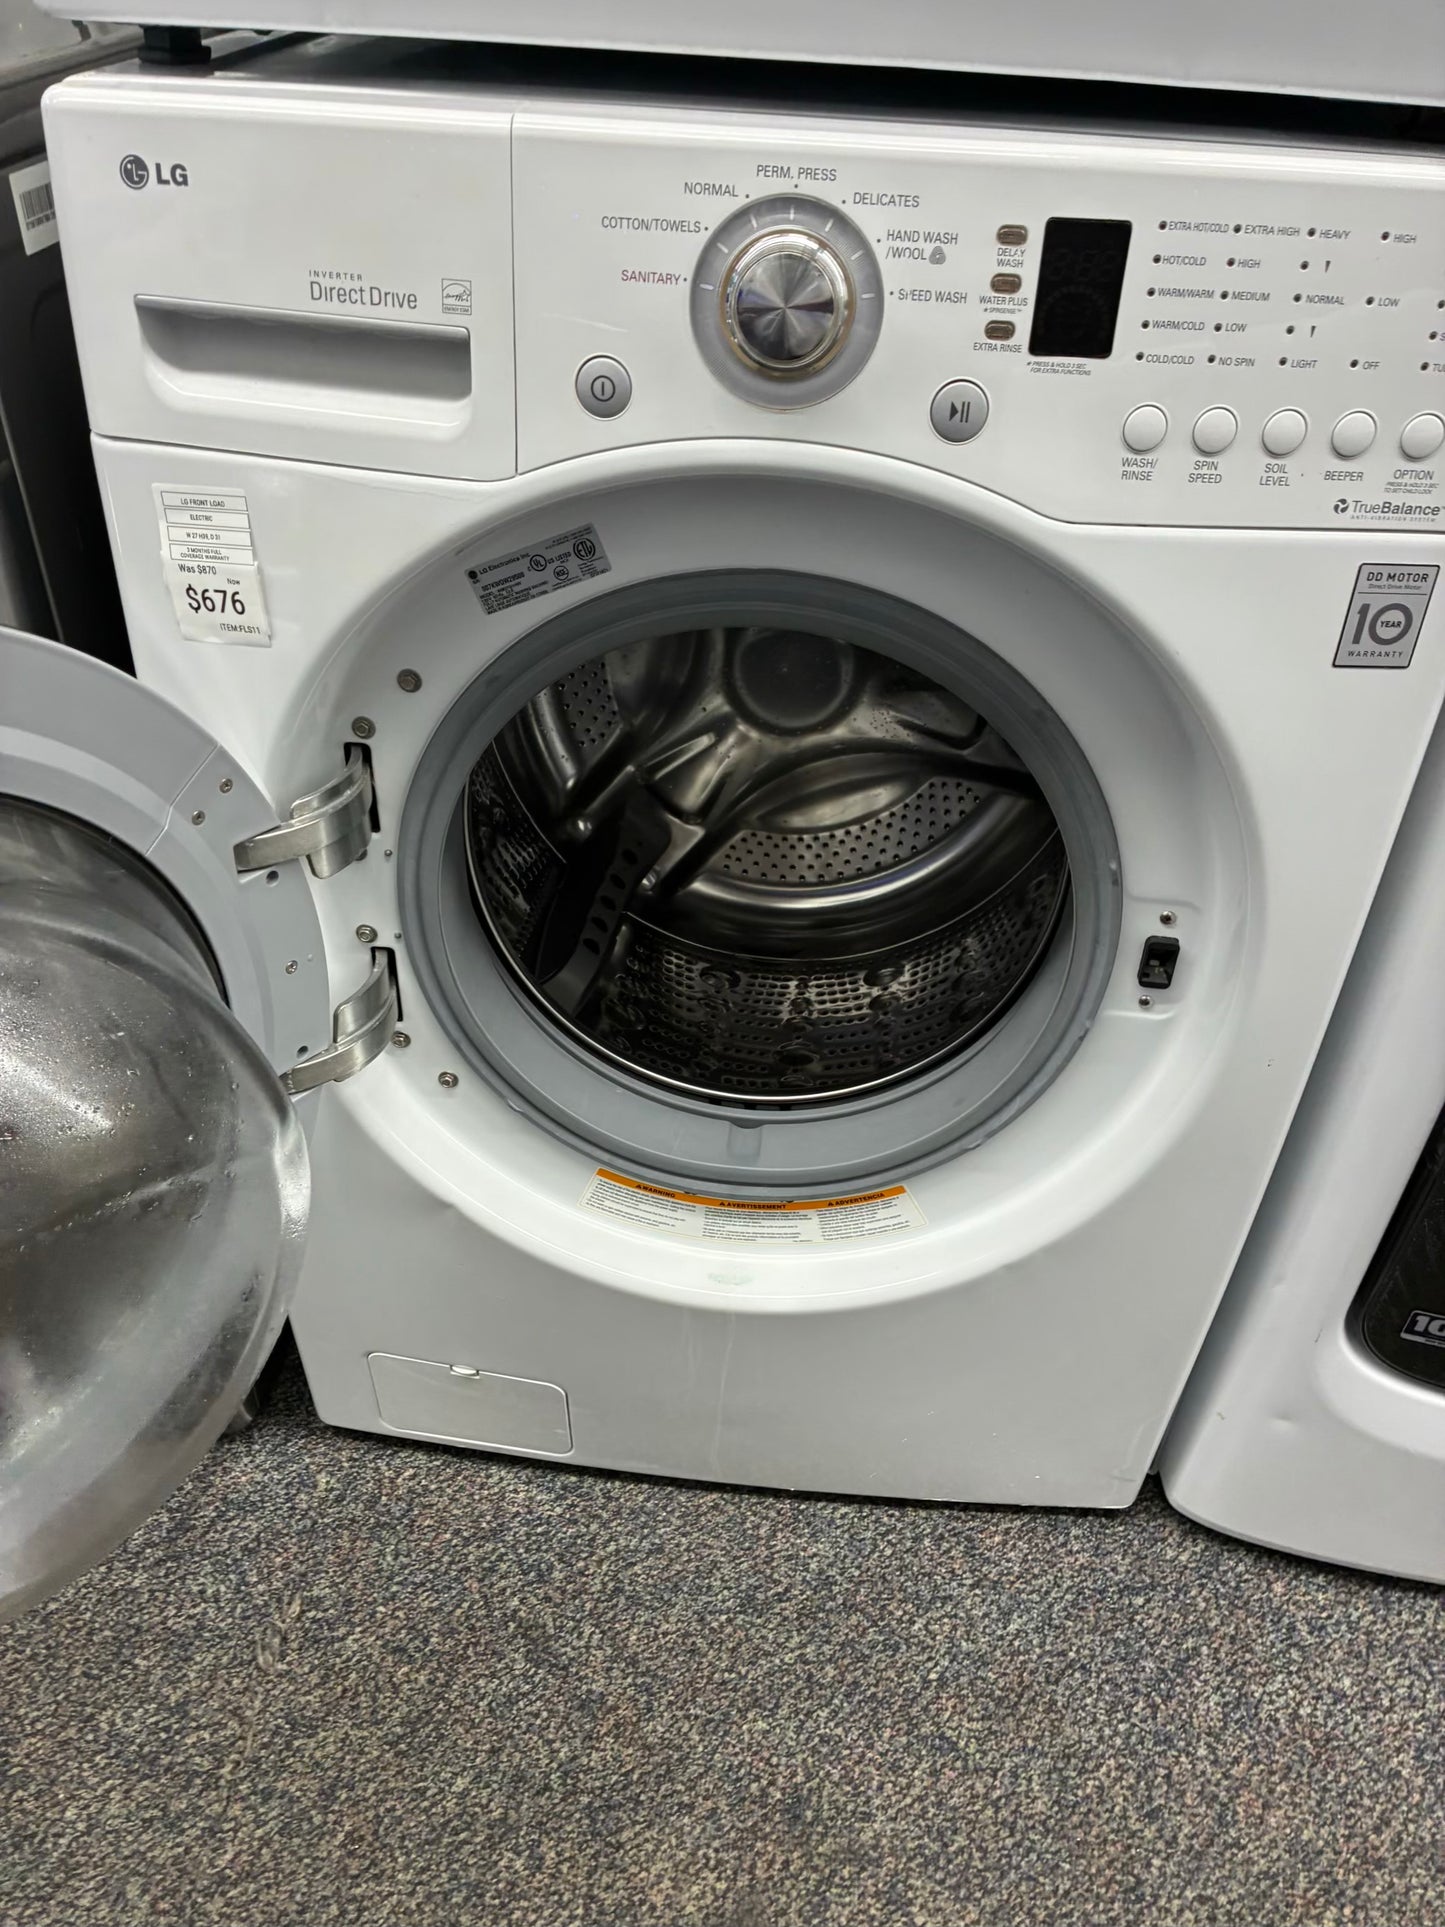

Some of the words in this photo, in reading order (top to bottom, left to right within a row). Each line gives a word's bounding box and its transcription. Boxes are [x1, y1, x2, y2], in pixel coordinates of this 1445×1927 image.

[155, 163, 189, 187] LG
[756, 164, 794, 179] PERM.
[798, 167, 837, 181] PRESS
[684, 182, 738, 197] NORMAL
[853, 192, 920, 208] DELICATES
[601, 216, 701, 233] COTTON/TOWELS
[1169, 221, 1192, 231] EXTRA
[1193, 223, 1229, 233] HOT/COLD
[1244, 225, 1275, 235] EXTRA
[1277, 227, 1300, 236] HIGH
[1320, 229, 1350, 239] HEAVY
[886, 229, 920, 242] HAND
[923, 231, 958, 245] WASH
[1393, 234, 1416, 243] HIGH
[885, 247, 927, 260] /WOOL
[997, 248, 1026, 257] DELAY
[997, 259, 1024, 268] WASH
[1162, 256, 1207, 266] HOT/COLD
[1237, 259, 1261, 268] HIGH
[309, 270, 363, 281] INVERTER
[621, 270, 681, 285] SANITARY
[935, 290, 968, 304] WASH
[1158, 287, 1215, 299] WARM/WARM
[1231, 291, 1271, 301] MEDIUM
[979, 296, 1006, 305] WATER
[1008, 297, 1028, 306] PLUS
[1305, 295, 1345, 305] NORMAL
[1378, 298, 1400, 307] LOW
[1152, 320, 1205, 331] WARM/COLD
[1225, 323, 1247, 332] LOW
[973, 342, 998, 351] EXTRA
[1000, 344, 1022, 353] RINSE
[1146, 354, 1195, 365] COLD/COLD
[1218, 357, 1233, 366] NO
[1234, 358, 1255, 367] SPIN
[1291, 359, 1318, 368] LIGHT
[1363, 361, 1380, 370] OFF
[1121, 457, 1158, 469] WASH/
[1194, 460, 1218, 471] SPIN
[1264, 463, 1288, 474] SOIL
[1121, 470, 1153, 481] RINSE
[1188, 473, 1222, 484] SPEED
[1324, 471, 1364, 481] BEEPER
[1393, 469, 1434, 480] OPTION
[1259, 476, 1290, 486] LEVEL
[1352, 500, 1440, 515] TrueBalance
[178, 564, 195, 574] Was
[197, 565, 216, 575] $870
[1367, 572, 1383, 581] DD
[1387, 572, 1428, 582] MOTOR
[186, 584, 245, 615] $676
[1352, 603, 1413, 645] 10
[642, 1186, 675, 1198] WARNING
[835, 1193, 885, 1206] ADVERTENCIA
[727, 1202, 786, 1210] AVERTISSEMENT
